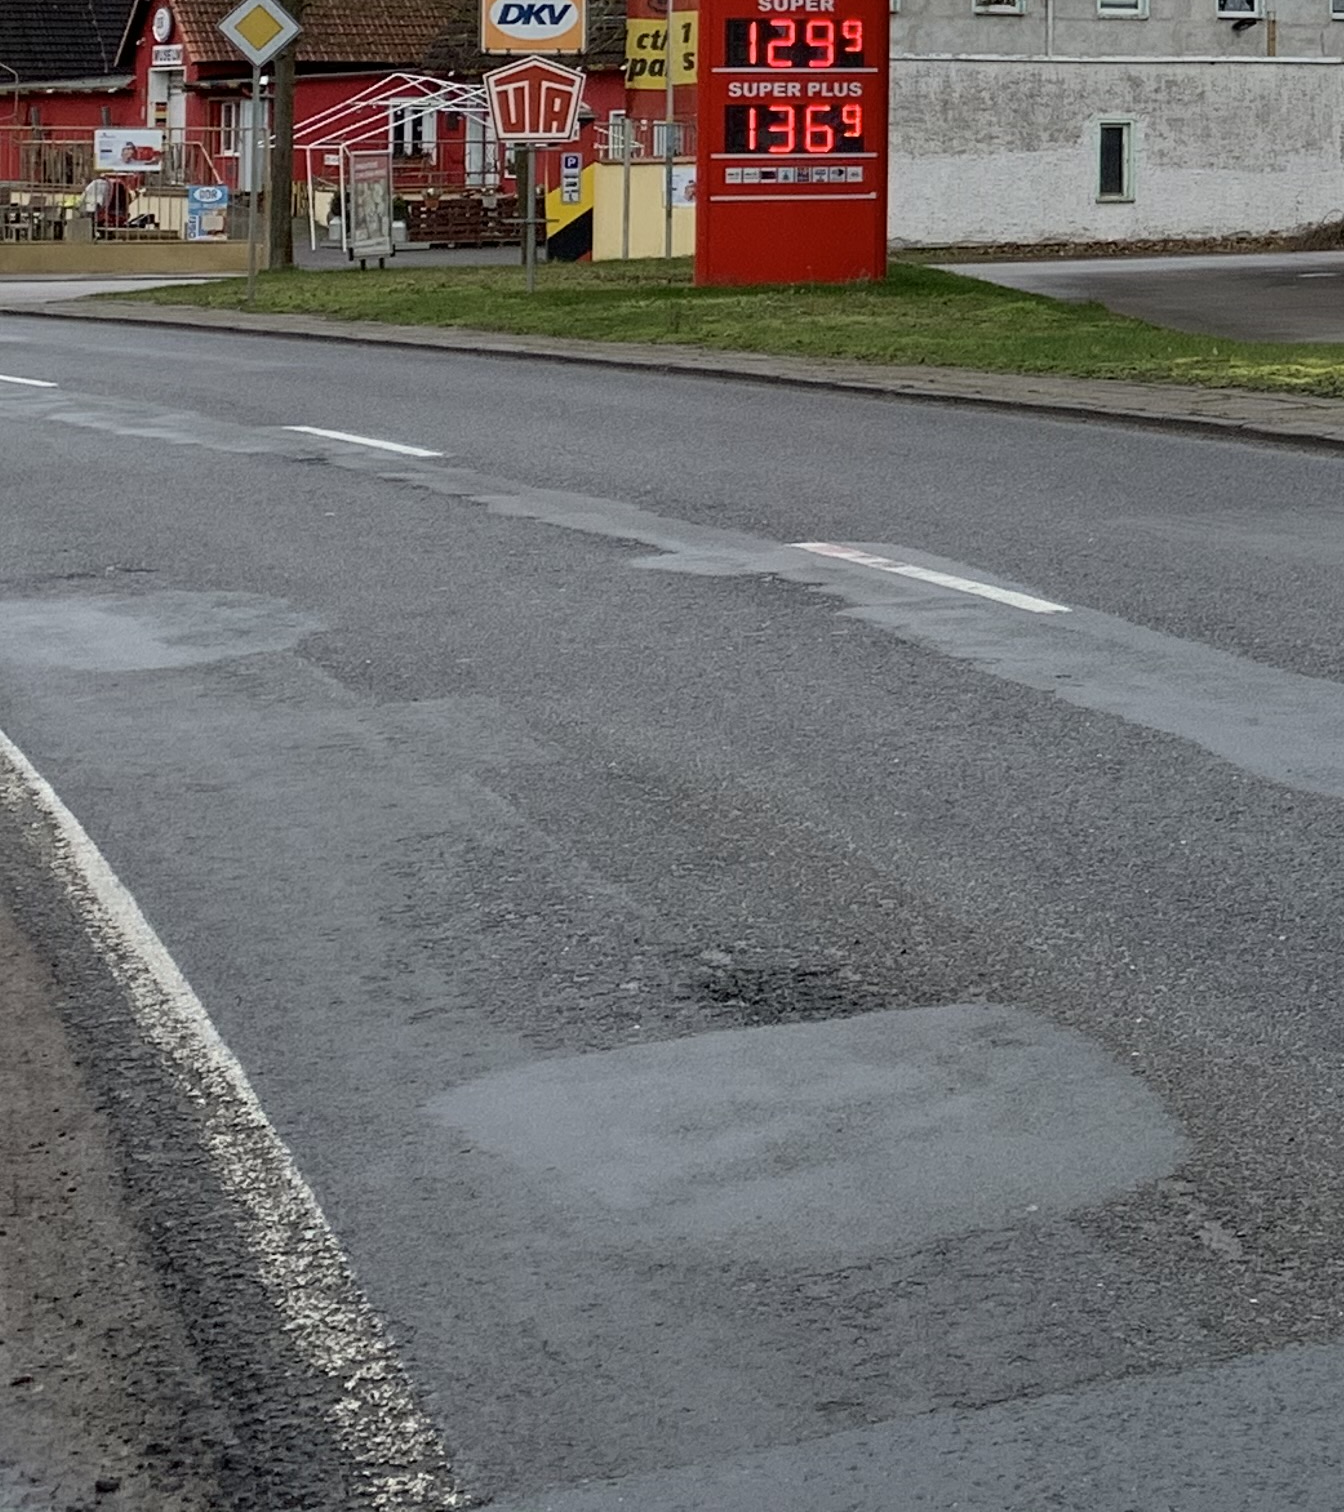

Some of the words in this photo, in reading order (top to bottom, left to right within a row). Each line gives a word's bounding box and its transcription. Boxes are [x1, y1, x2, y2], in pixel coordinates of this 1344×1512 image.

[497, 3, 572, 26] DKV
[749, 18, 863, 68] 1299
[494, 65, 576, 134] UTA
[728, 81, 801, 97] SUPER
[807, 81, 862, 97] PLUS
[749, 103, 862, 153] 1369
